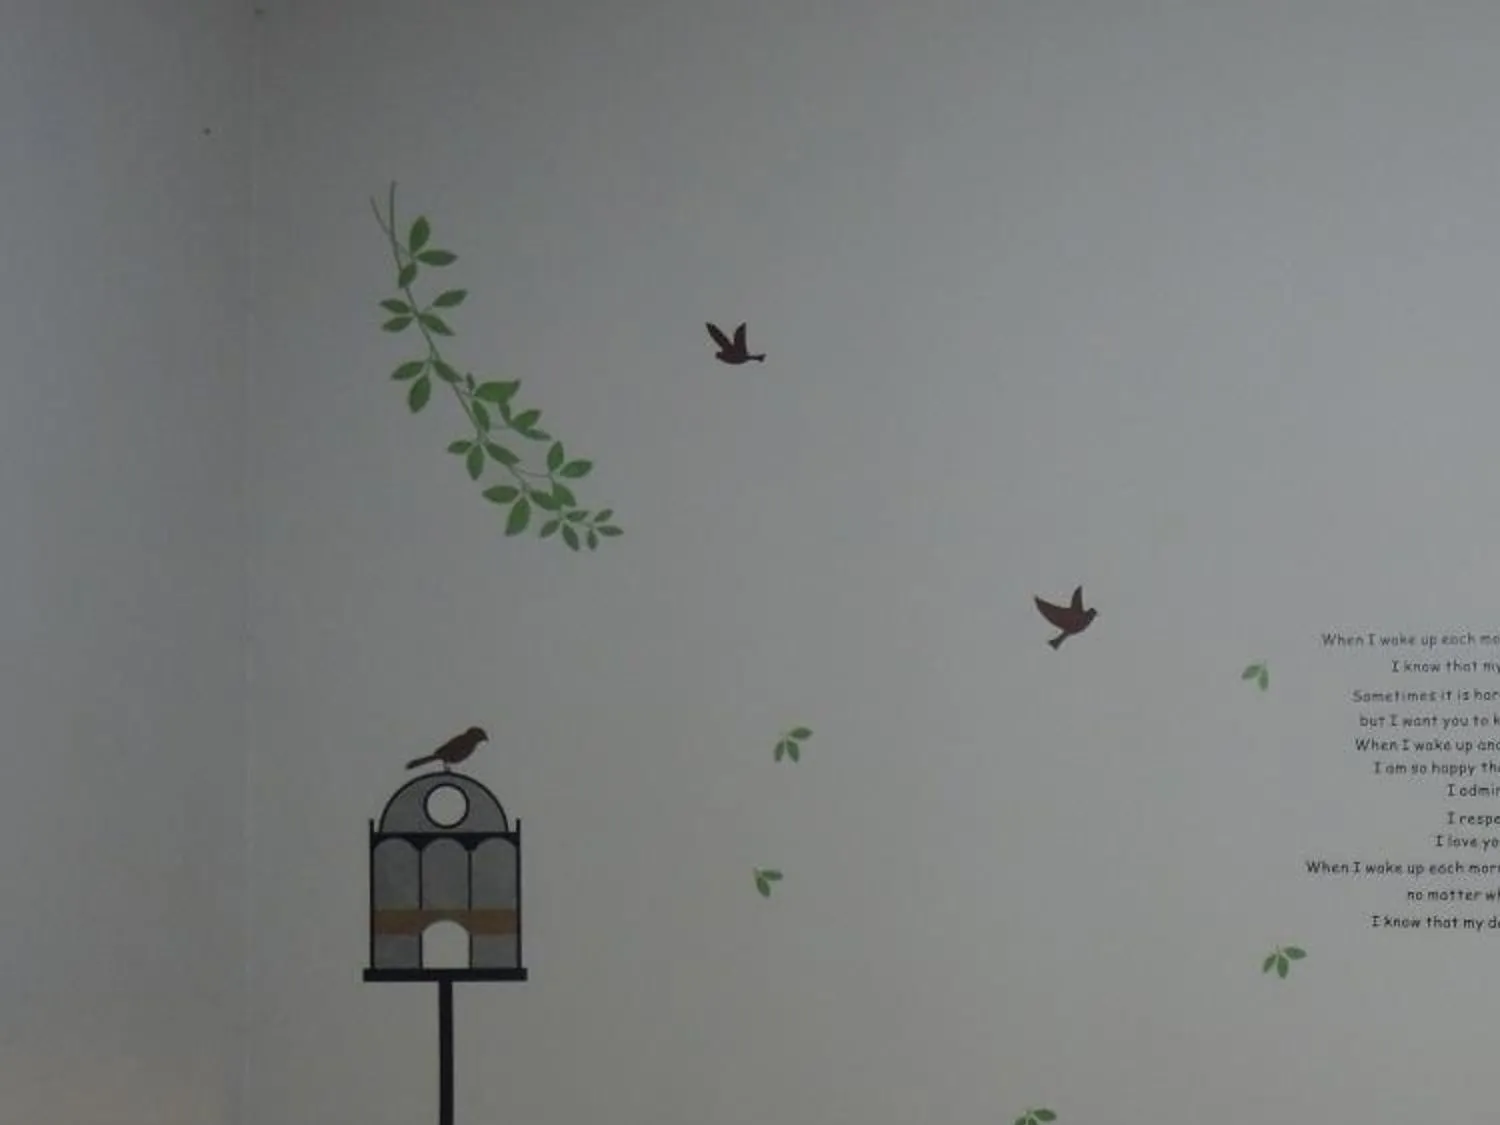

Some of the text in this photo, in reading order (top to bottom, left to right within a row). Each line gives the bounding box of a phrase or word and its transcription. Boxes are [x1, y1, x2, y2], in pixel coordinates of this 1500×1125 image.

[1321, 633, 1364, 647] When
[1368, 634, 1376, 646] I
[1380, 632, 1416, 647] wake
[1421, 635, 1437, 650] up
[1441, 632, 1476, 645] each
[1391, 660, 1399, 673] I
[1403, 660, 1441, 672] know
[1446, 660, 1478, 673] that
[1353, 690, 1437, 703] Sometimes
[1441, 690, 1453, 701] it
[1457, 689, 1470, 702] is
[1359, 714, 1386, 727] but
[1389, 714, 1398, 727] I
[1402, 715, 1438, 727] want
[1442, 716, 1469, 730] you
[1474, 715, 1489, 727] to
[1355, 738, 1399, 751] When
[1402, 739, 1411, 751] I
[1413, 739, 1452, 751] wake
[1455, 741, 1473, 754] up
[1374, 761, 1381, 774] I
[1385, 765, 1407, 774] am
[1411, 763, 1427, 774] so
[1432, 761, 1476, 776] happy
[1447, 784, 1456, 797] I
[1447, 811, 1456, 825] I
[1435, 835, 1444, 847] I
[1447, 835, 1478, 848] love
[1306, 860, 1349, 874] When
[1353, 861, 1361, 873] I
[1365, 861, 1403, 874] wake
[1408, 863, 1425, 879] up
[1429, 861, 1465, 875] each
[1408, 890, 1424, 901] no
[1428, 890, 1482, 901] matter
[1372, 916, 1380, 927] I
[1384, 916, 1421, 928] know
[1427, 916, 1459, 929] that
[1464, 919, 1484, 932] my
